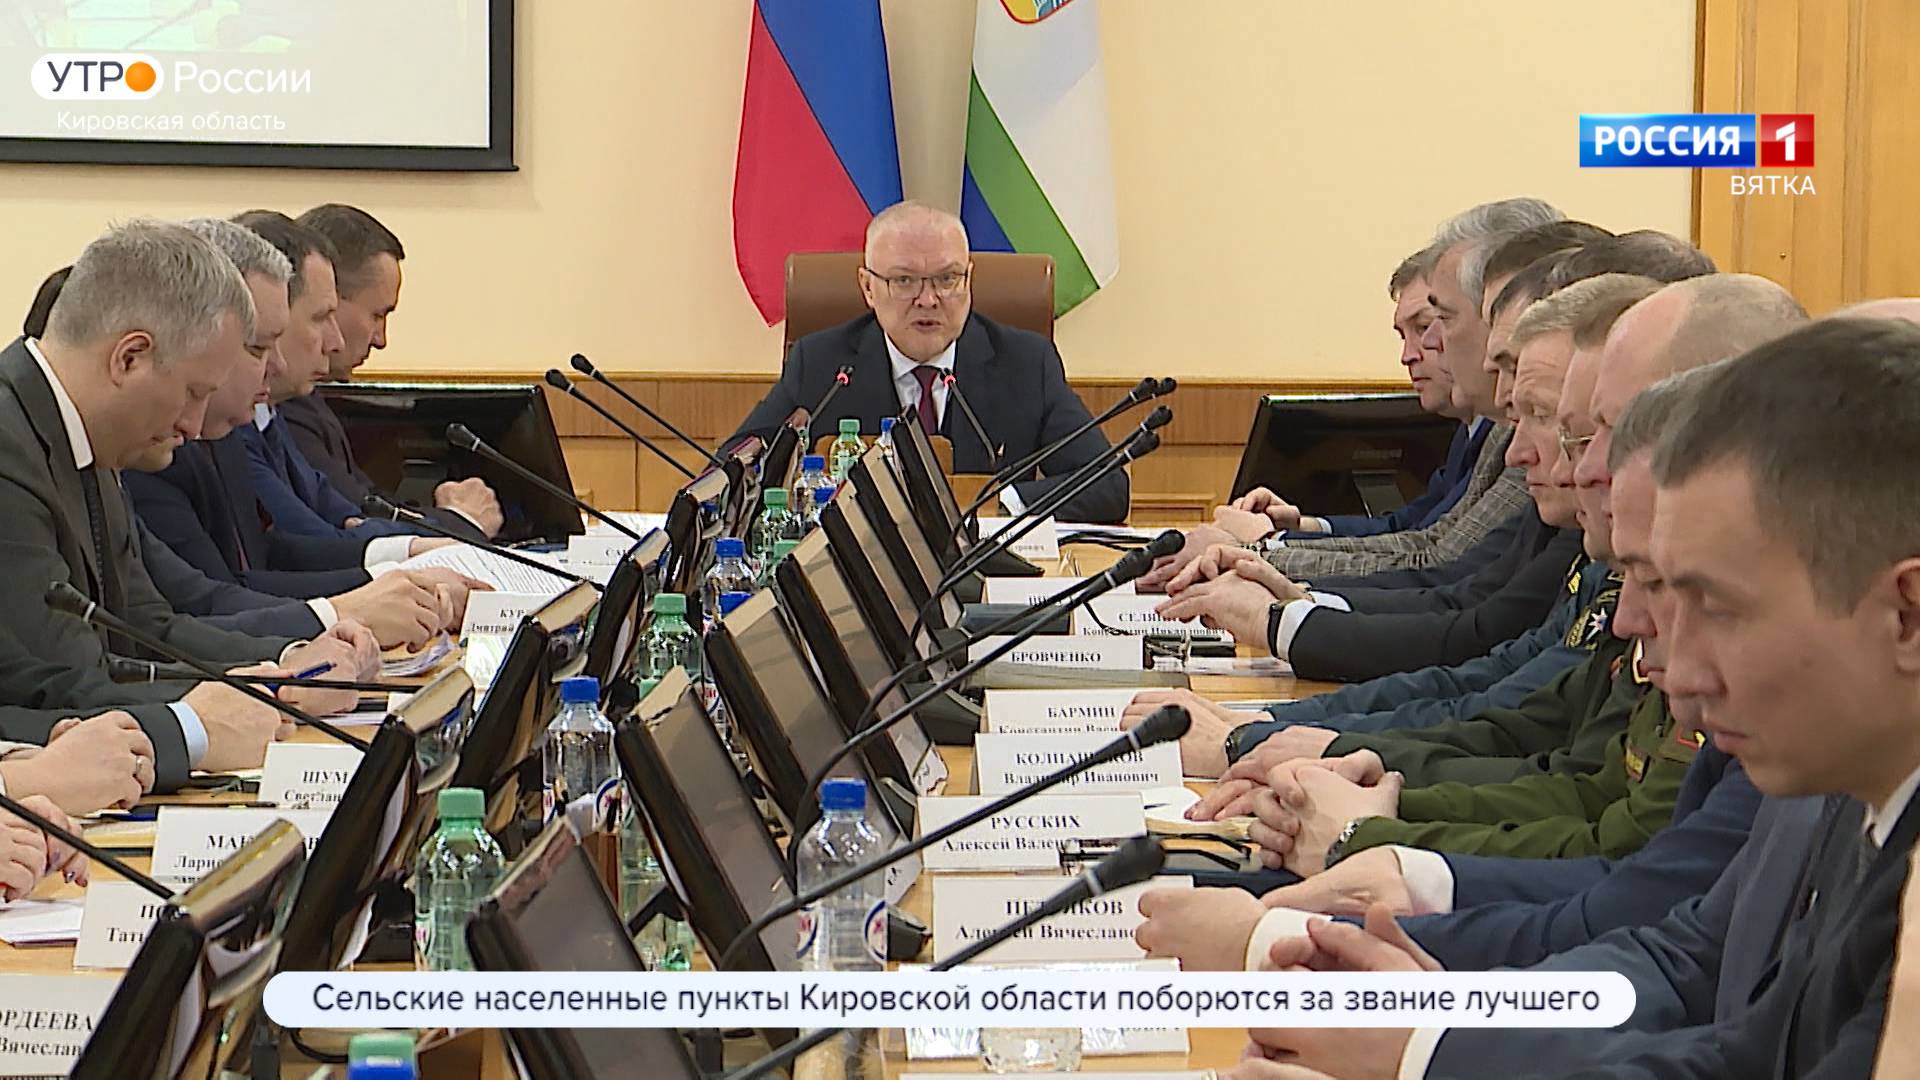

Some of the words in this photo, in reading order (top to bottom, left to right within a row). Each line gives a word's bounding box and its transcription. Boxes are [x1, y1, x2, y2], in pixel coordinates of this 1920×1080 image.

[1011, 651, 1102, 664] БРОВЧЕНКО
[1048, 706, 1116, 719] БАРМИН
[1085, 770, 1159, 784] Иванович
[990, 815, 1081, 830] РУССКИХ
[943, 837, 1010, 853] Алексей
